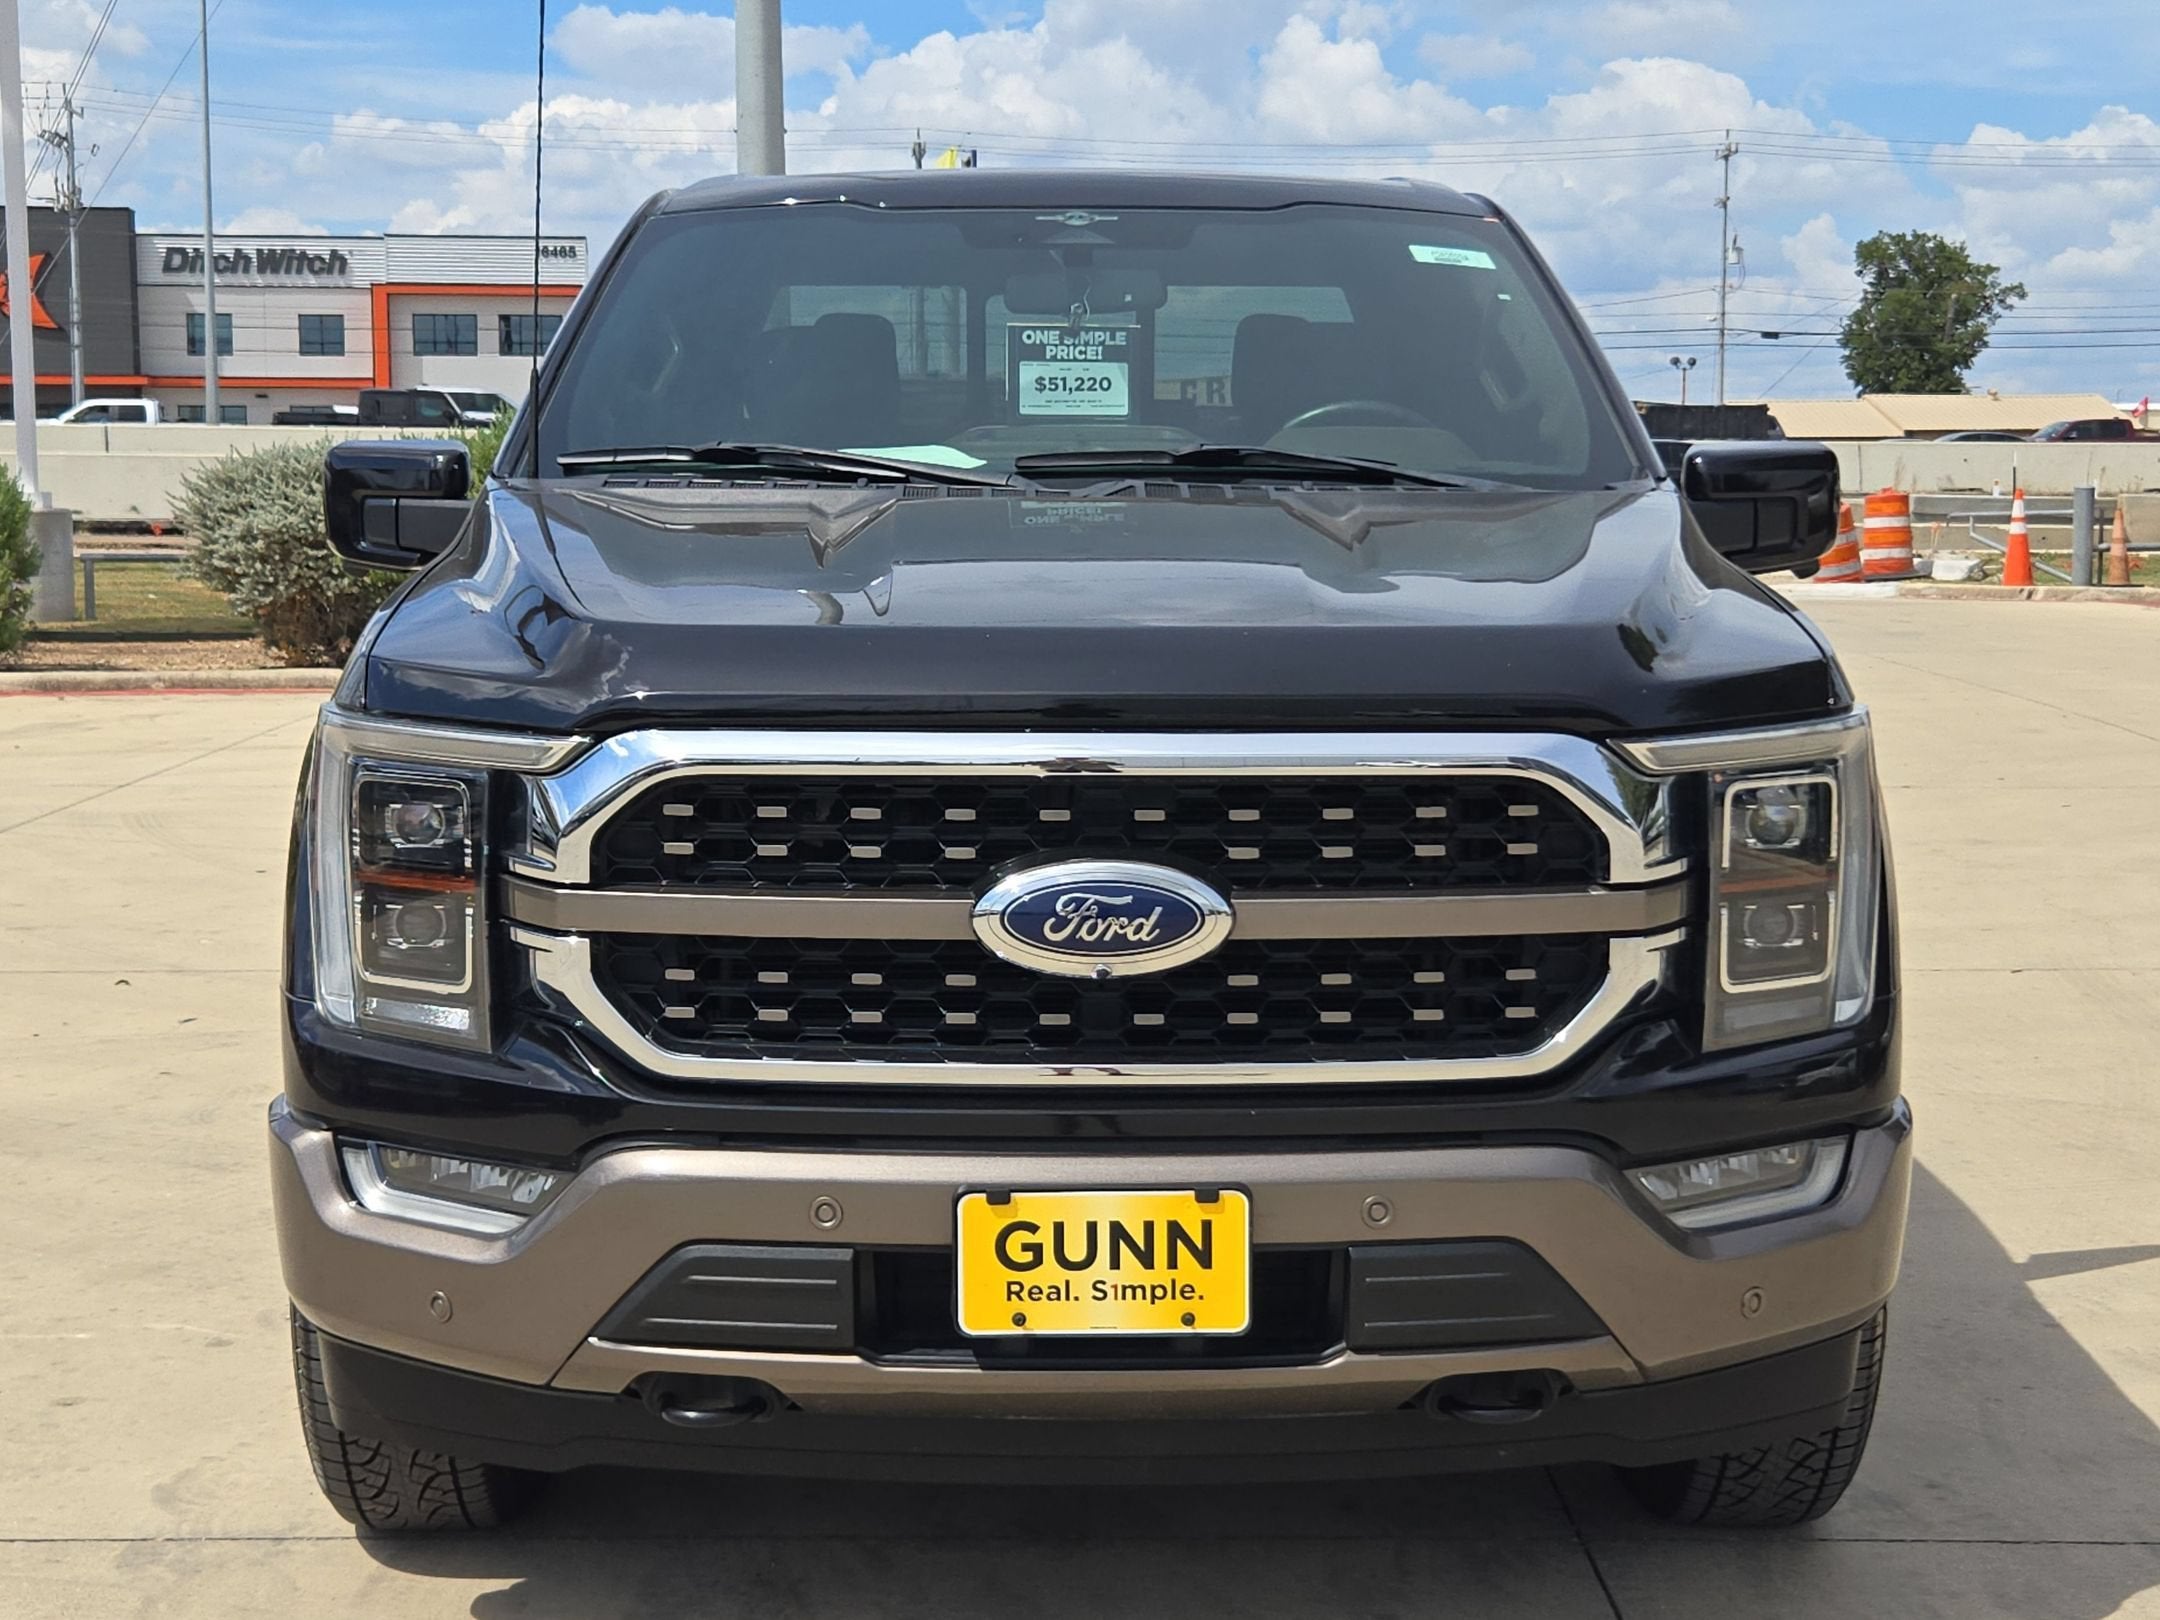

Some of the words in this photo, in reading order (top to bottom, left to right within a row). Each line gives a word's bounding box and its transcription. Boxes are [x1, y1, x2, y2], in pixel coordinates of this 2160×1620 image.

[256, 248, 348, 275] Witch
[1021, 330, 1060, 345] ONE
[1045, 345, 1103, 360] PRICE!
[1034, 376, 1112, 396] $51,220
[1043, 892, 1163, 941] Ford
[994, 1219, 1213, 1272] GUNN
[1006, 1279, 1080, 1302] Real.
